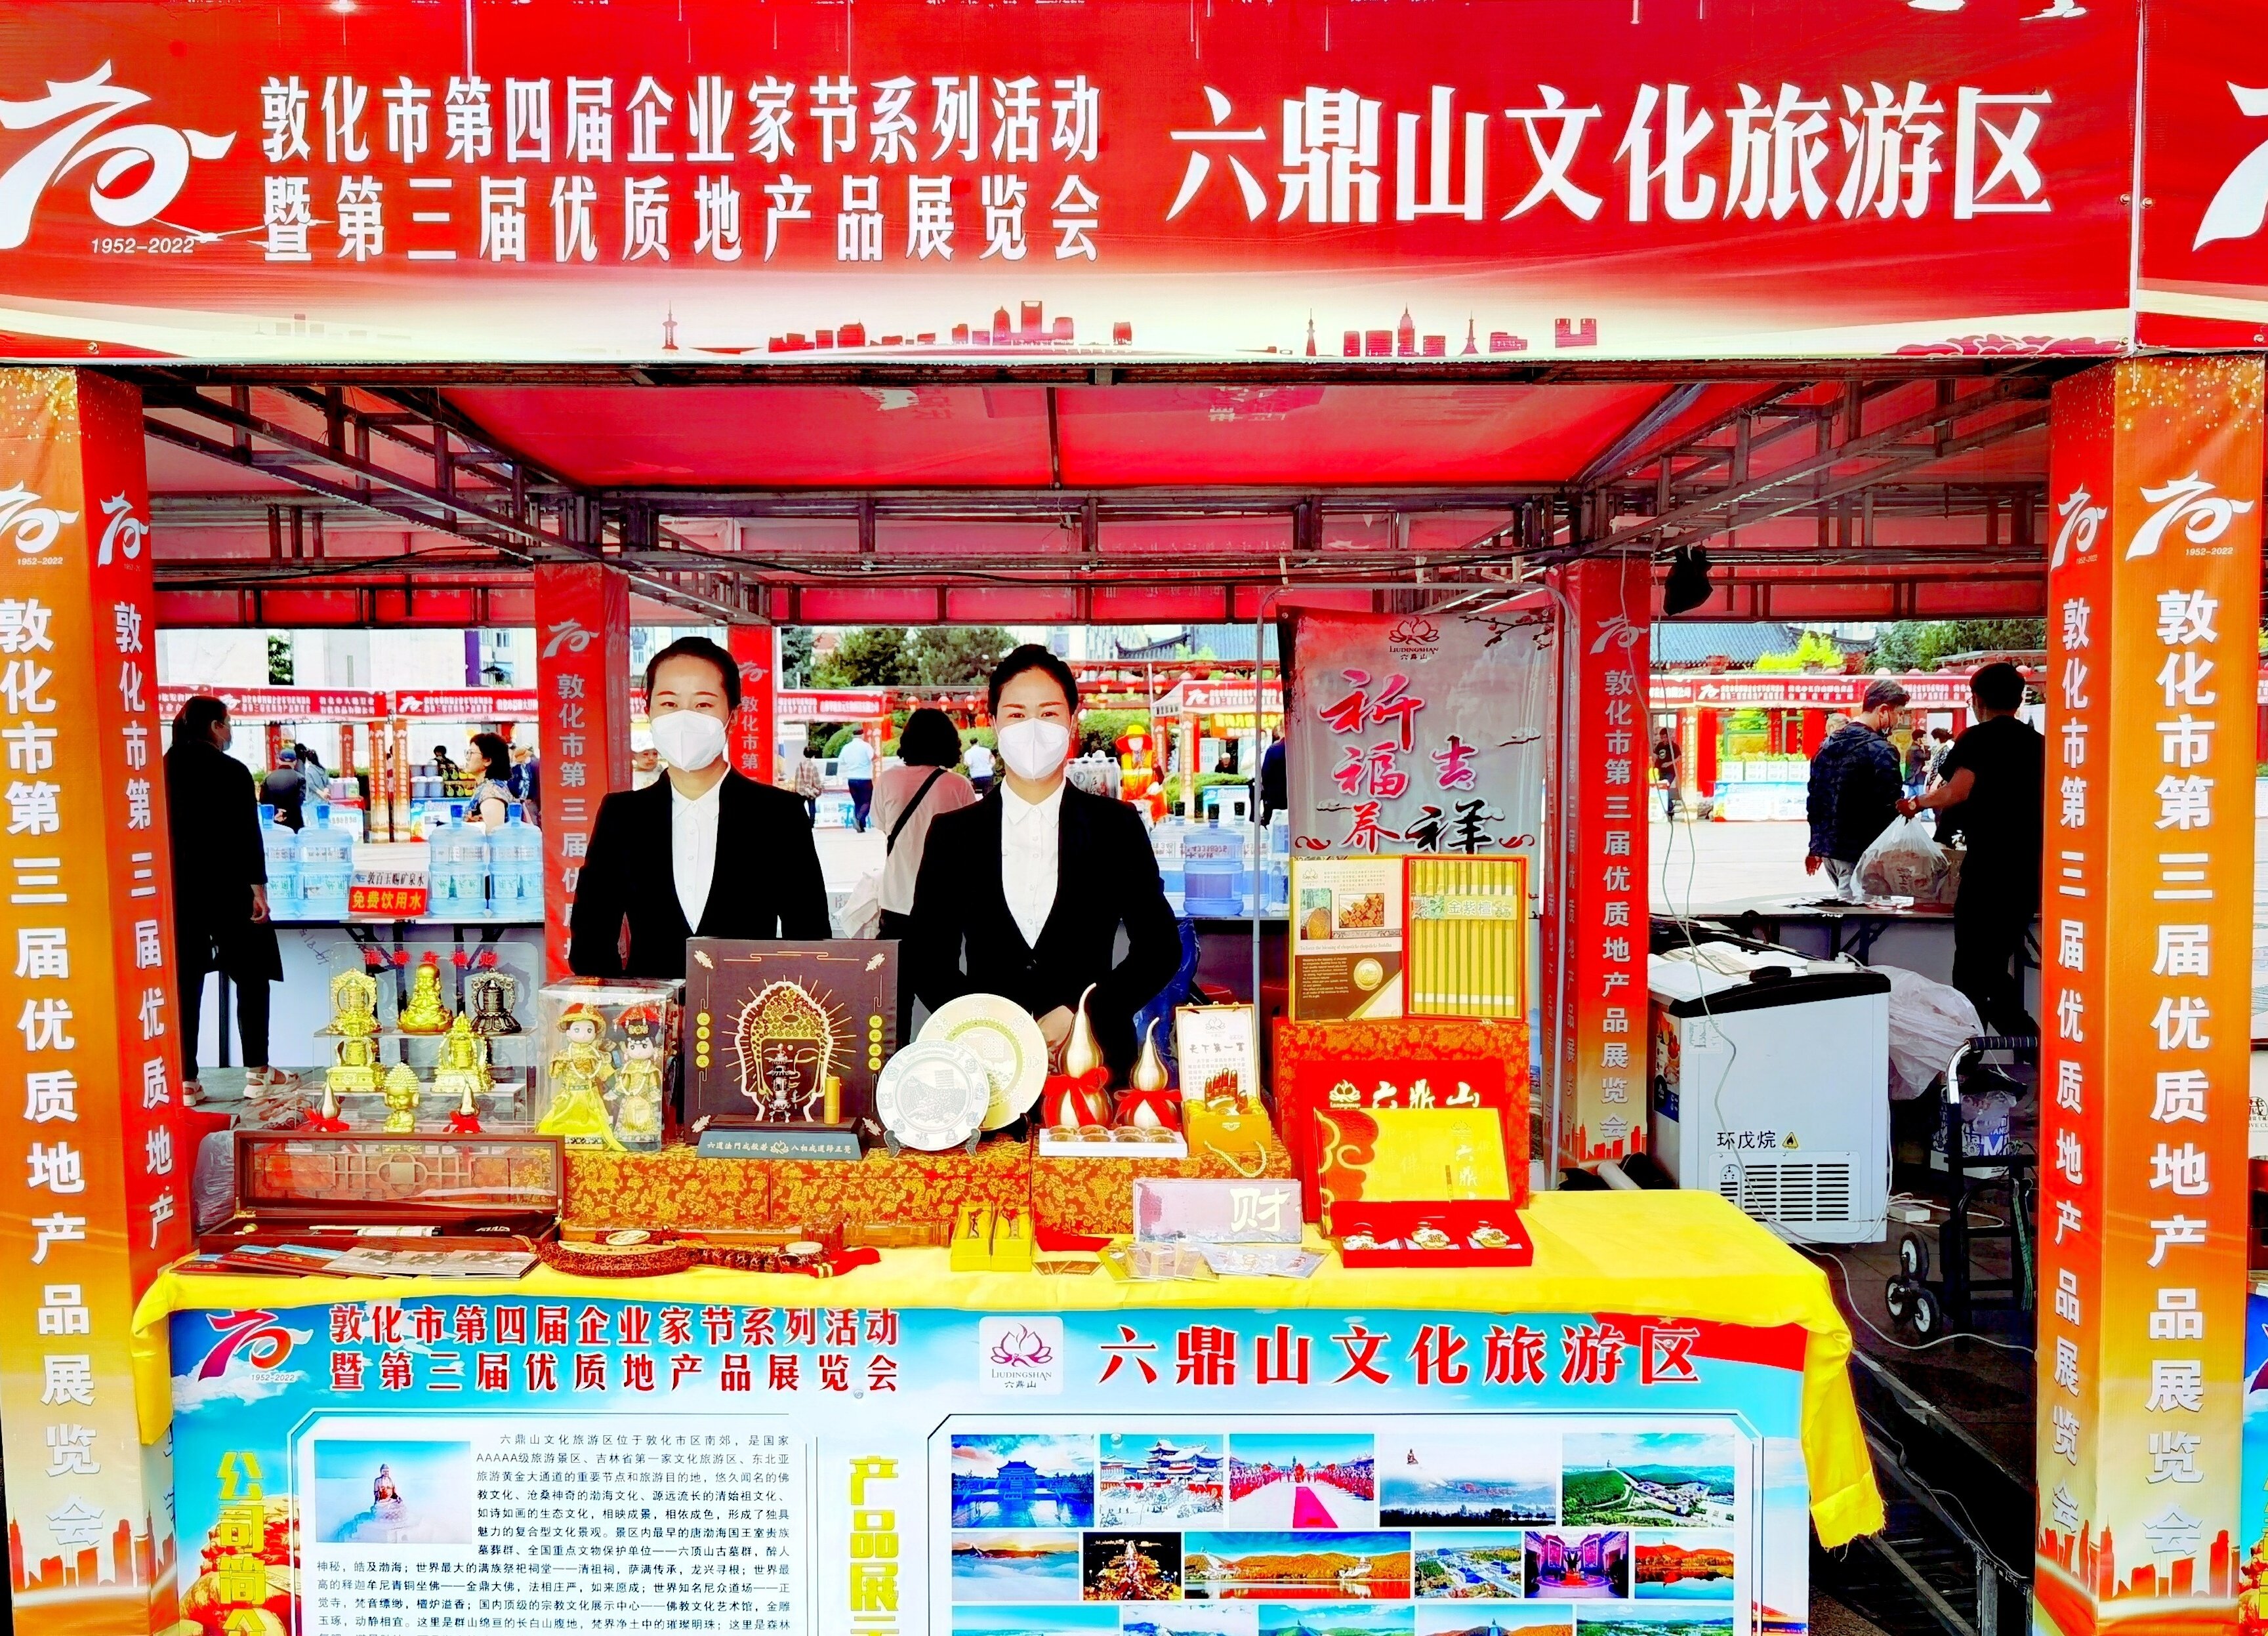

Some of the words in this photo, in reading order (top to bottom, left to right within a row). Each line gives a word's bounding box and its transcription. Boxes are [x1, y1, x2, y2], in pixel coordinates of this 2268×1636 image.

[260, 75, 1100, 164] 敦化市第四届企业家节系列活动
[1165, 81, 2052, 223] 六鼎山文化旅游区
[91, 237, 195, 254] 1952-2022
[264, 174, 1099, 262] 暨第三届优质地产品展览会
[352, 890, 422, 910] 免费饮用水
[1600, 670, 1633, 1139] 敦化市第三届优质地产品展览会
[0, 598, 104, 1546] 敦化市第三届优质地产品展览会
[2052, 597, 2090, 1536] 敦化市第三届优质地产品展览会
[2145, 588, 2218, 1556] 敦化市第三届优质地产品展览会
[1716, 1131, 1777, 1150] 环戊烷
[1231, 1187, 1290, 1233] 财
[330, 1304, 899, 1345] 敦化市第四届企业家节系列活动
[1098, 1324, 1701, 1385] 六鼎山文化旅游区
[331, 1353, 899, 1392] 暨第三届优质地产品展览会
[992, 1368, 1052, 1381] LIUDINGSHAN
